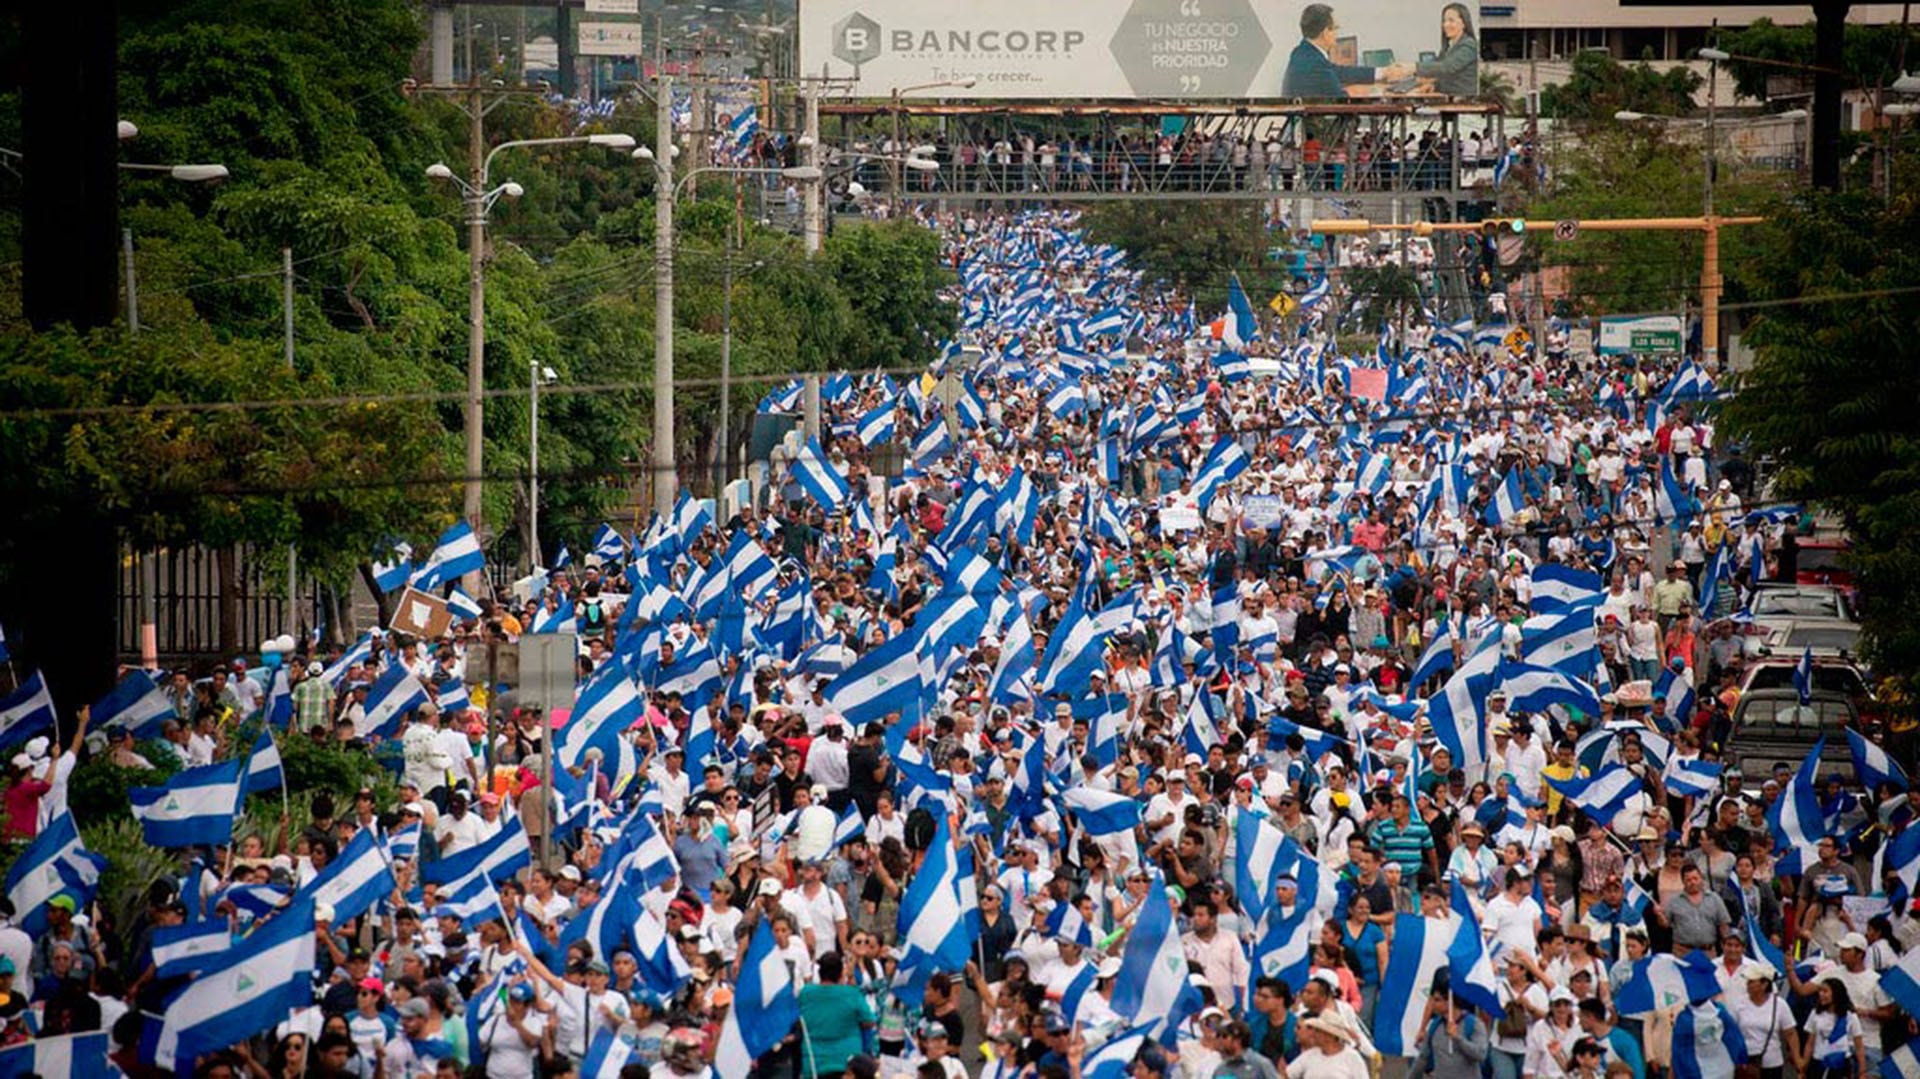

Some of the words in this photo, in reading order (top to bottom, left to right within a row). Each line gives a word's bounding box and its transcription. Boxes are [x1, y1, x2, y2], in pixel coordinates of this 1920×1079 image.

[1144, 22, 1164, 37] TU
[1166, 22, 1239, 37] NEGOCIO
[845, 28, 869, 50] B
[891, 30, 1085, 52] BANCORP
[1165, 39, 1228, 52] NUESTRA
[1151, 54, 1229, 68] PRIORIDAD
